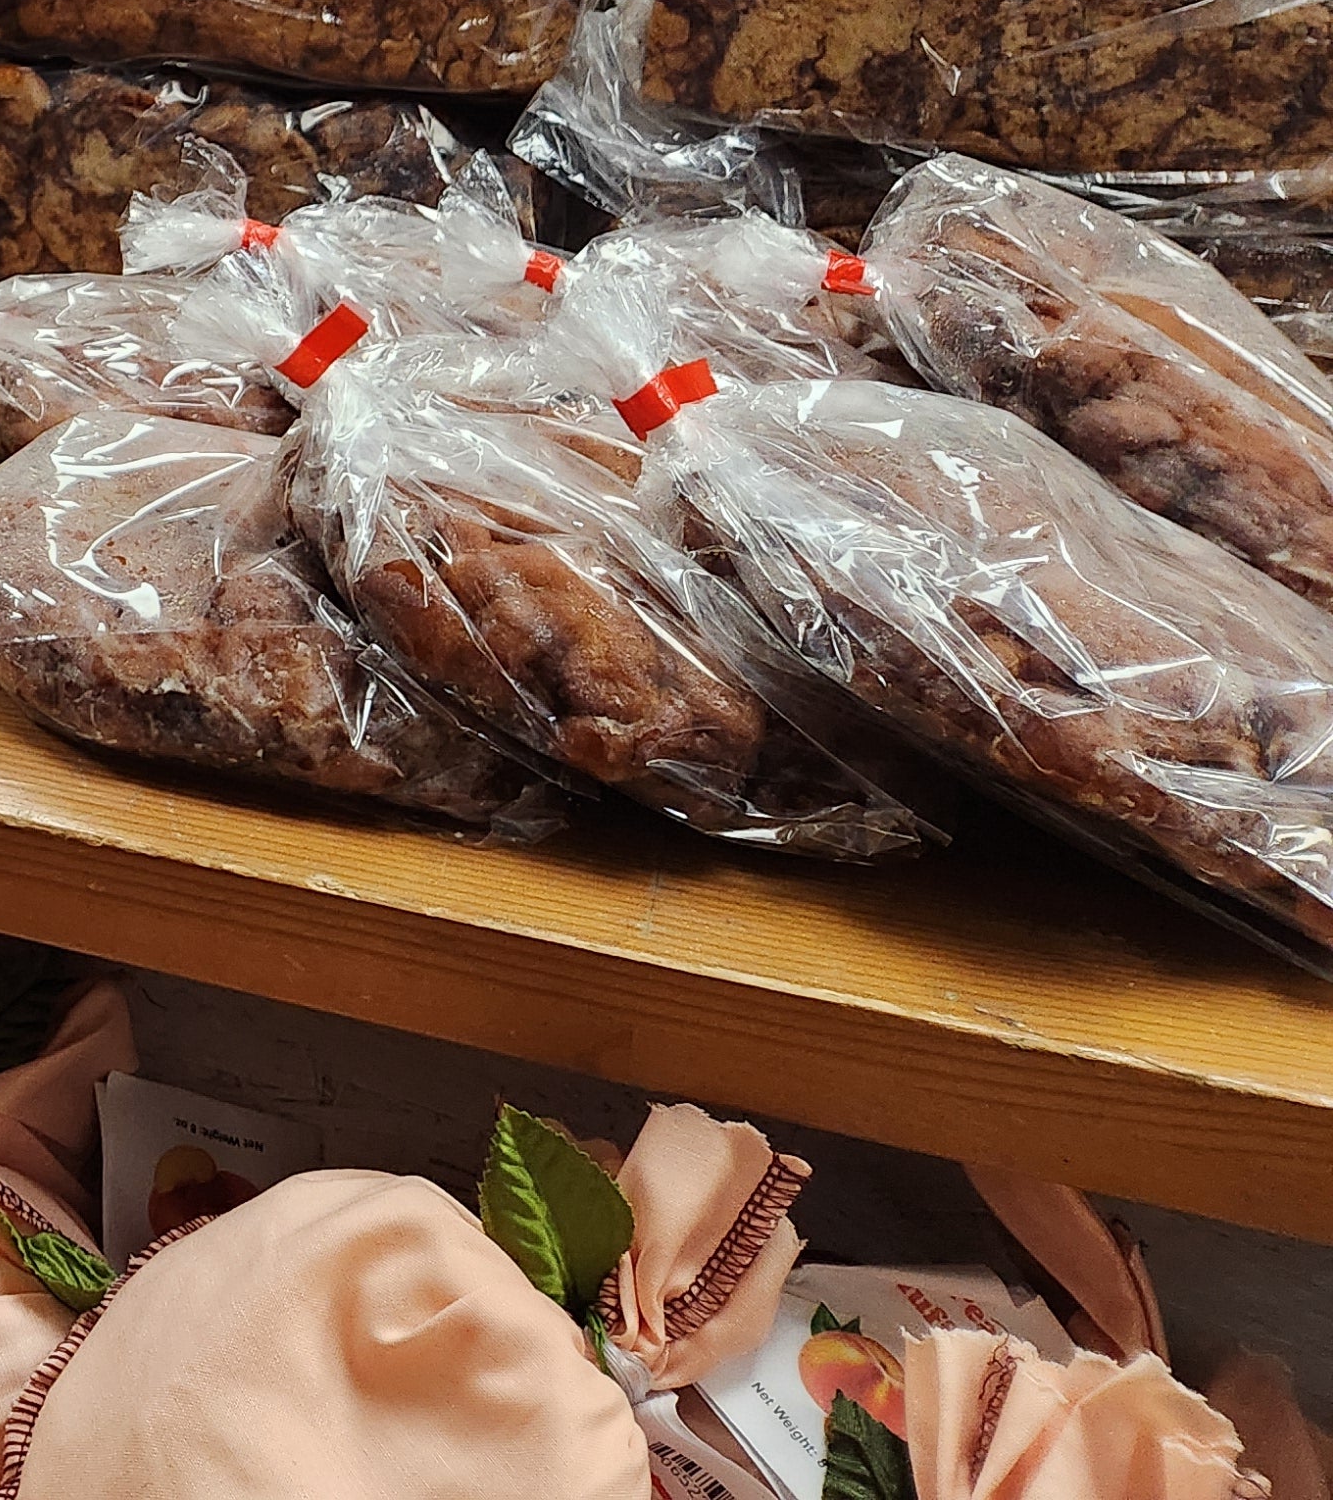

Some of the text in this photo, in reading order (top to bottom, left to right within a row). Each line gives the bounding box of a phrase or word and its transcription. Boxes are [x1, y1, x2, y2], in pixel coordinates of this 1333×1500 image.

[242, 1138, 265, 1153] Net
[751, 1381, 774, 1409] Net
[772, 1401, 819, 1457] Weight:
